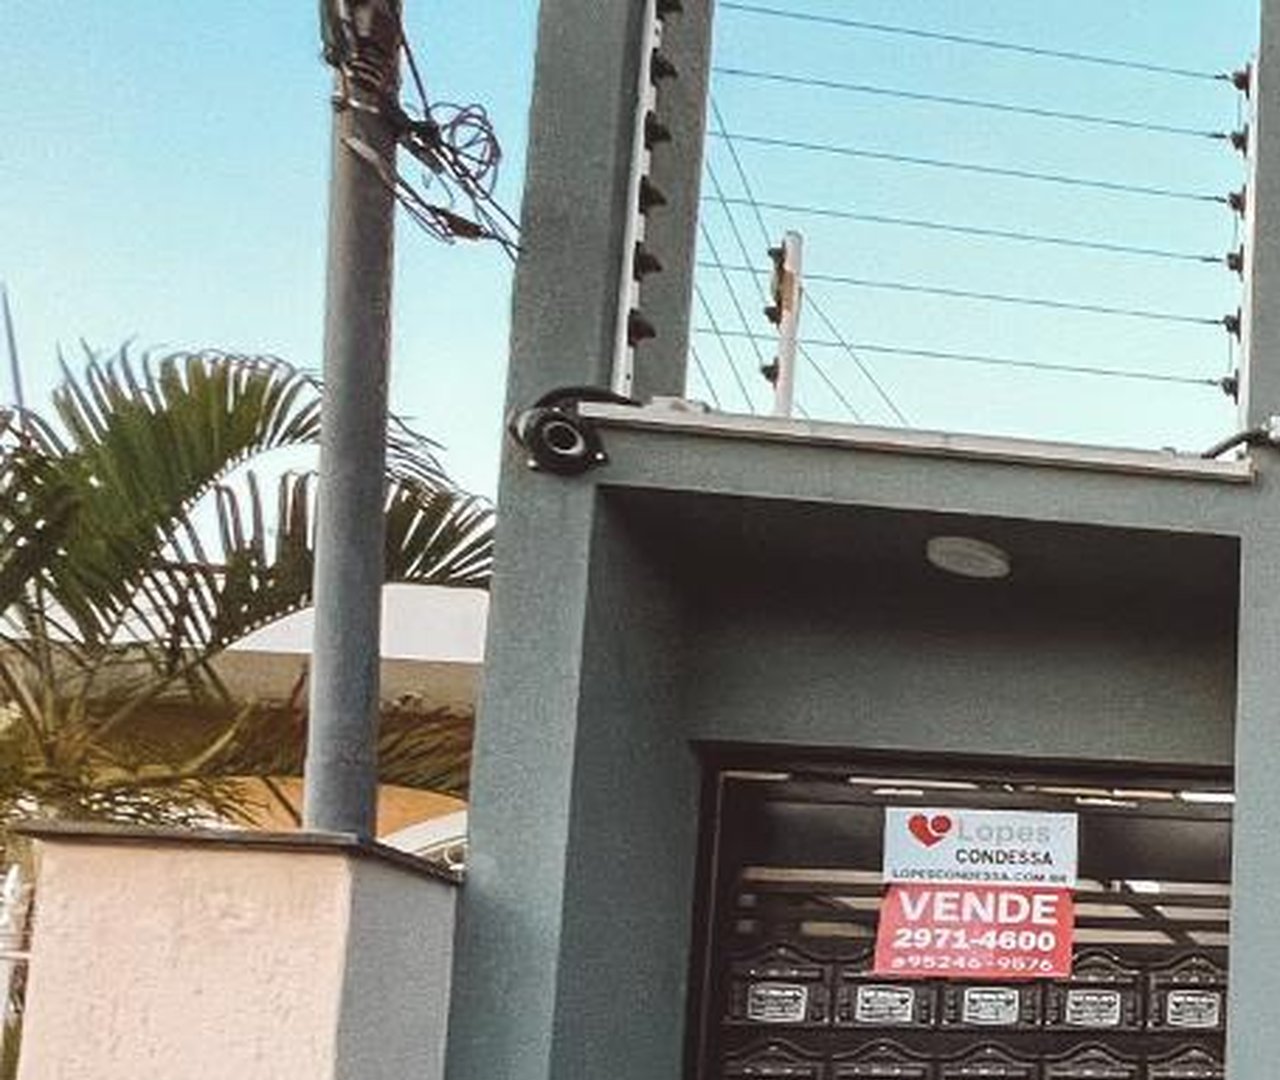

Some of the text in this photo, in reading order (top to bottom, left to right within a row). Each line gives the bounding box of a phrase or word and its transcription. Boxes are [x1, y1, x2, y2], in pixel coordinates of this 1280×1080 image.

[956, 816, 1053, 845] Lopes
[954, 848, 1054, 866] CONDESSA
[899, 890, 1060, 926] VENDE
[892, 927, 1057, 953] 2971-4600
